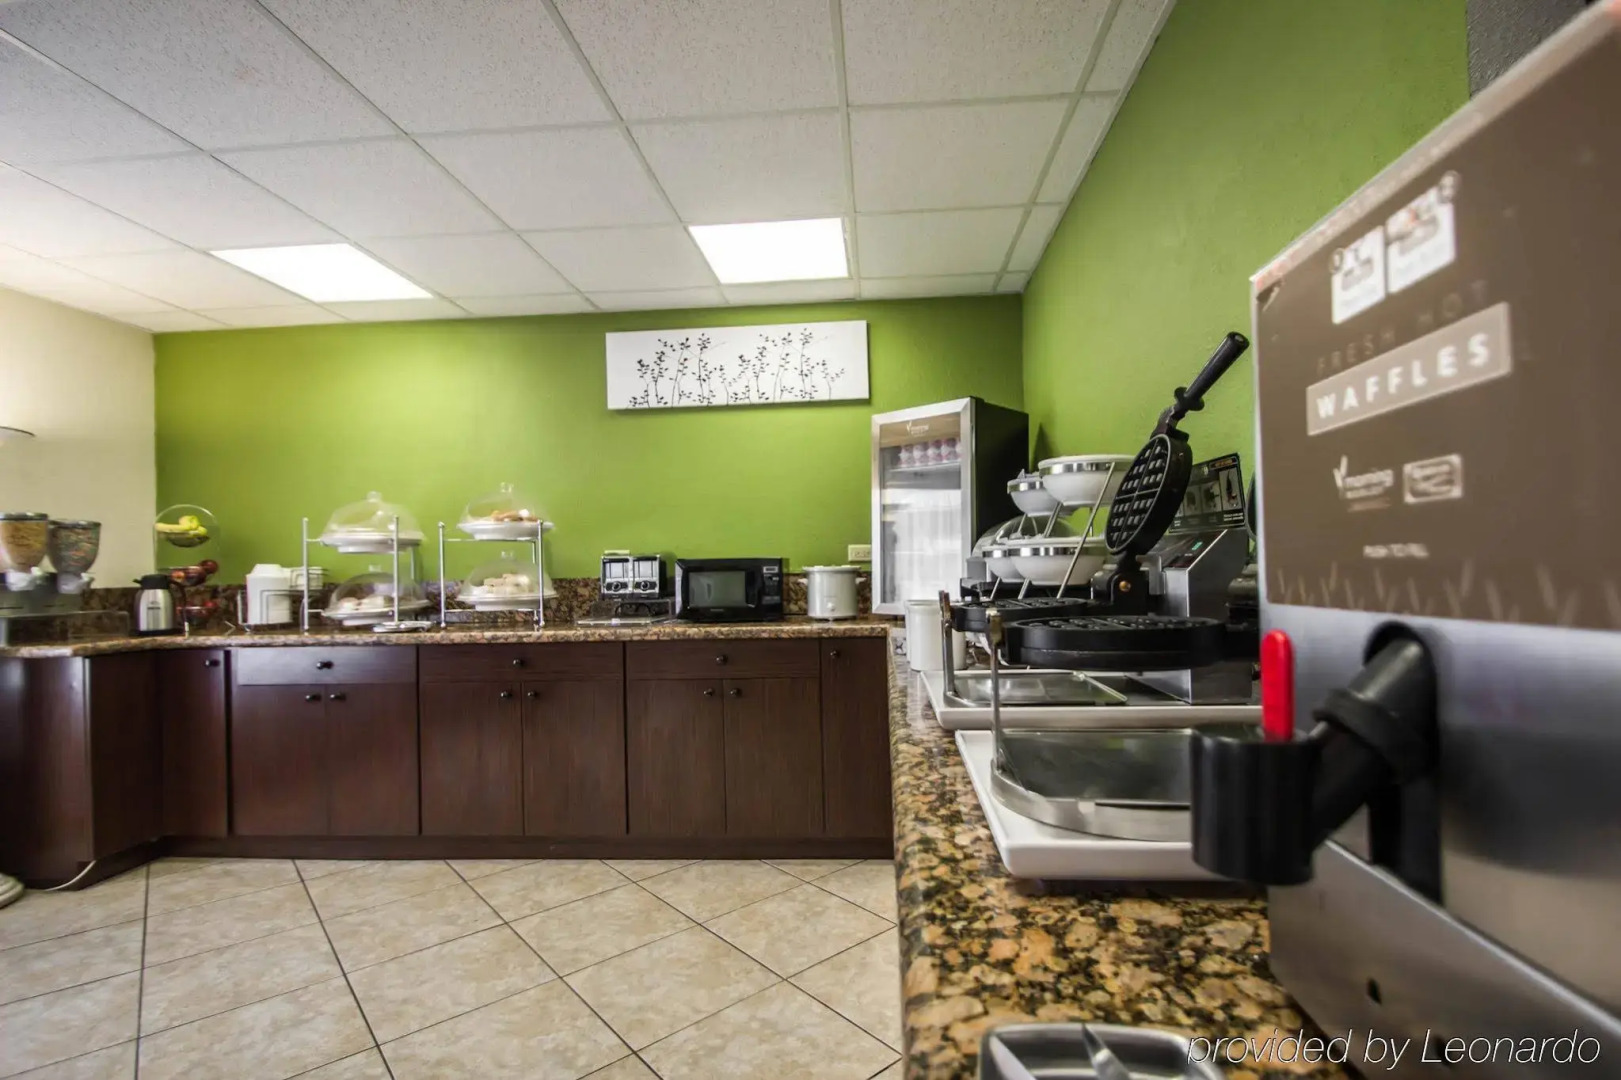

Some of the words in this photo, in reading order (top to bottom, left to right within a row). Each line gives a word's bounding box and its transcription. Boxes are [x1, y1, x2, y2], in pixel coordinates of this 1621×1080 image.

[1316, 328, 1395, 376] FRESH
[1417, 279, 1488, 329] HOT
[1316, 333, 1489, 418] WAFFLES
